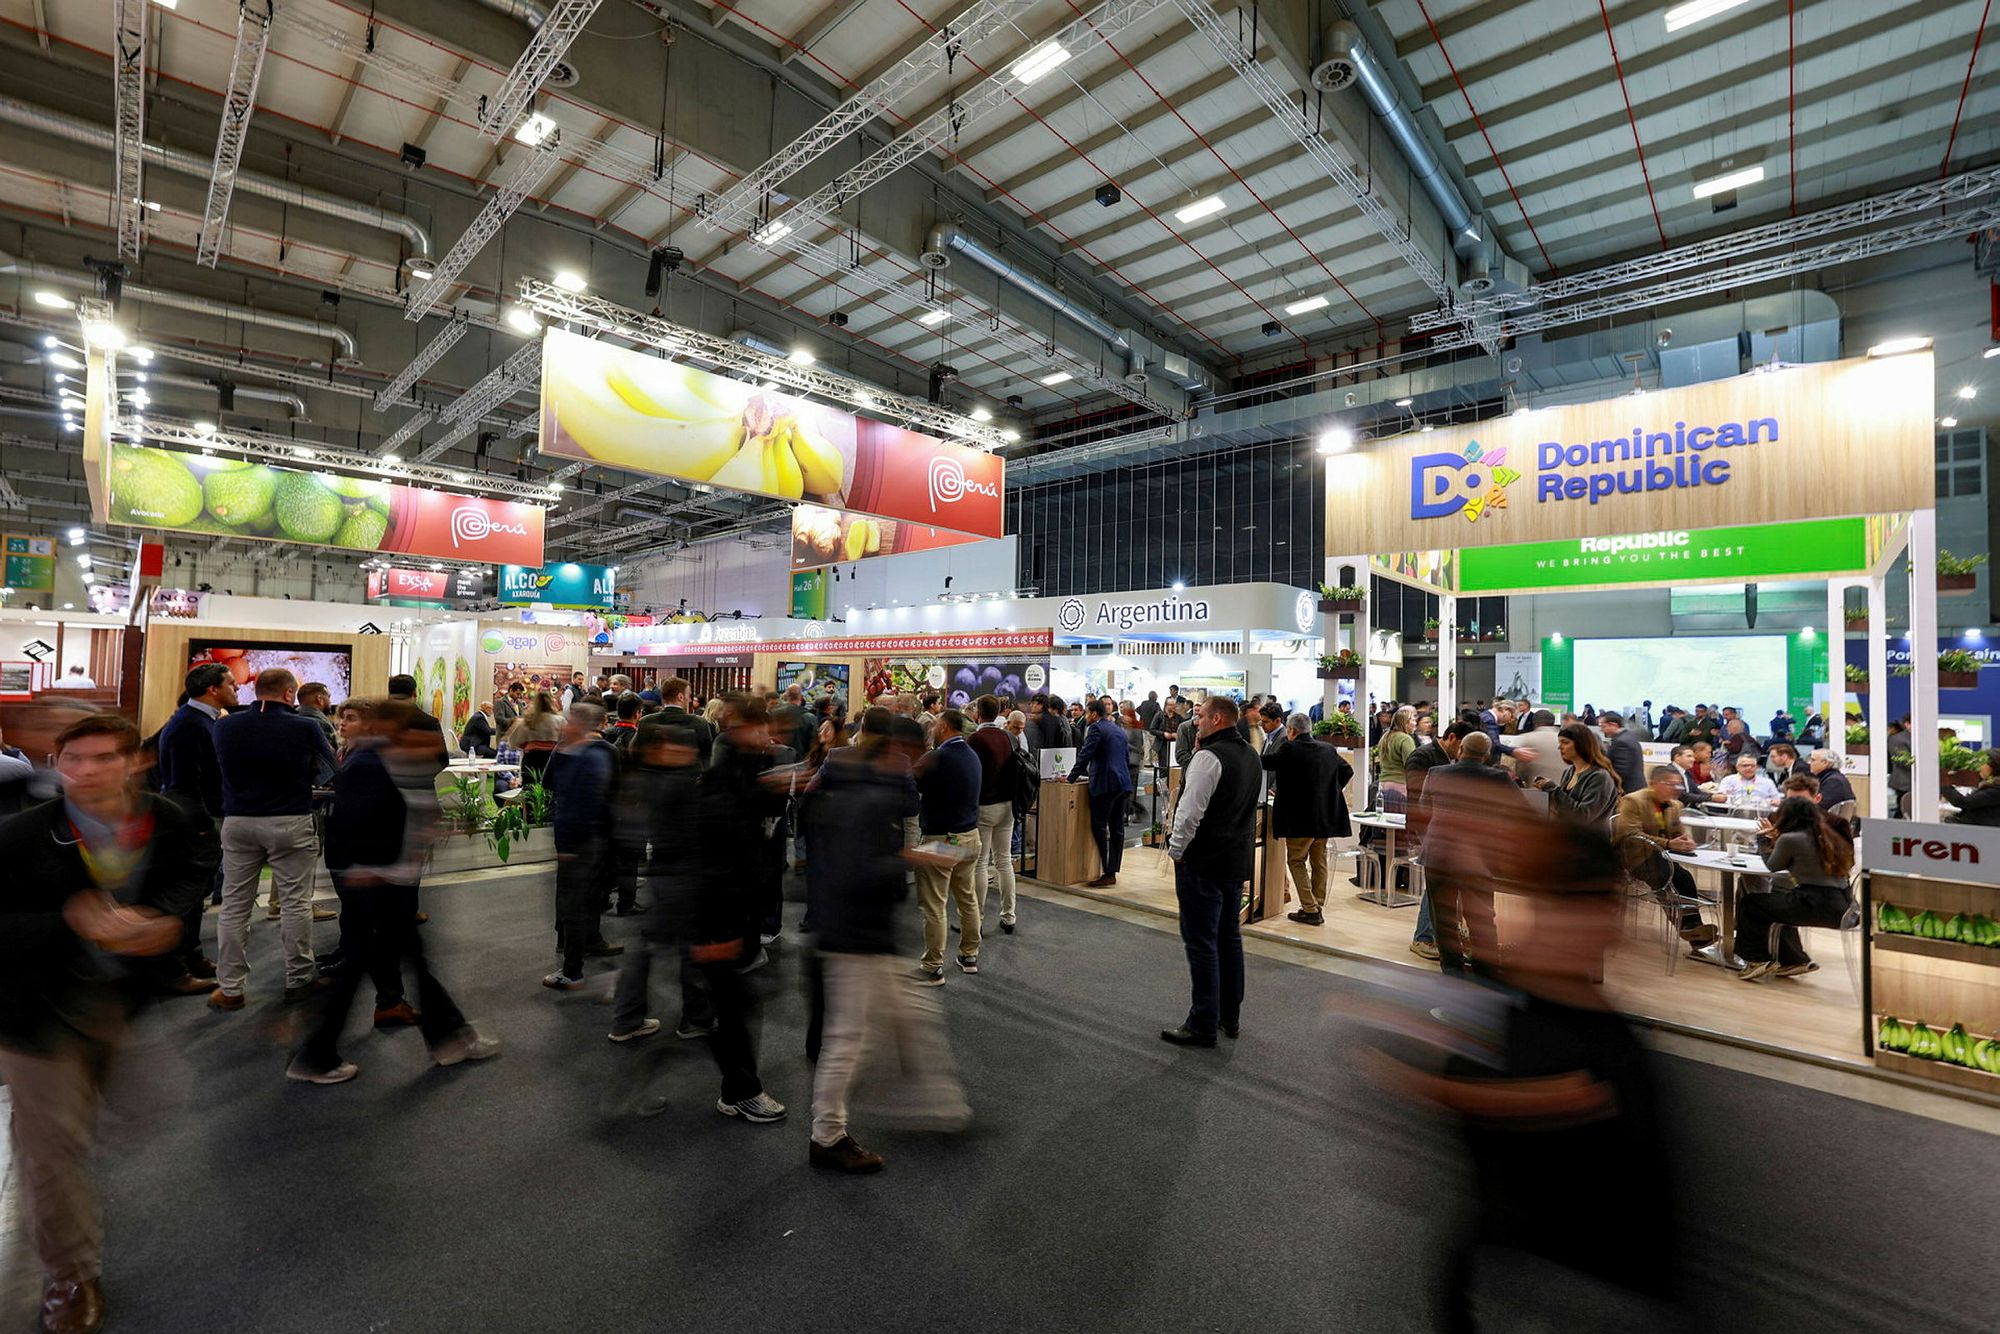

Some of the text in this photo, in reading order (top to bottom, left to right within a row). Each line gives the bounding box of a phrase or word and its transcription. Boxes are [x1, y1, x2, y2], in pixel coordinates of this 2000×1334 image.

[1538, 417, 1779, 471] Dominican
[928, 456, 998, 512] Perú
[1538, 453, 1731, 505] Republic
[451, 507, 527, 548] Perú
[1581, 532, 1690, 554] Republic
[1537, 546, 1745, 568] WE BRING YOU THE BEST
[505, 572, 538, 590] ALCO
[803, 580, 813, 591] 26
[1097, 597, 1208, 630] Argentina
[507, 636, 537, 650] agap
[1892, 837, 1980, 864] iren
